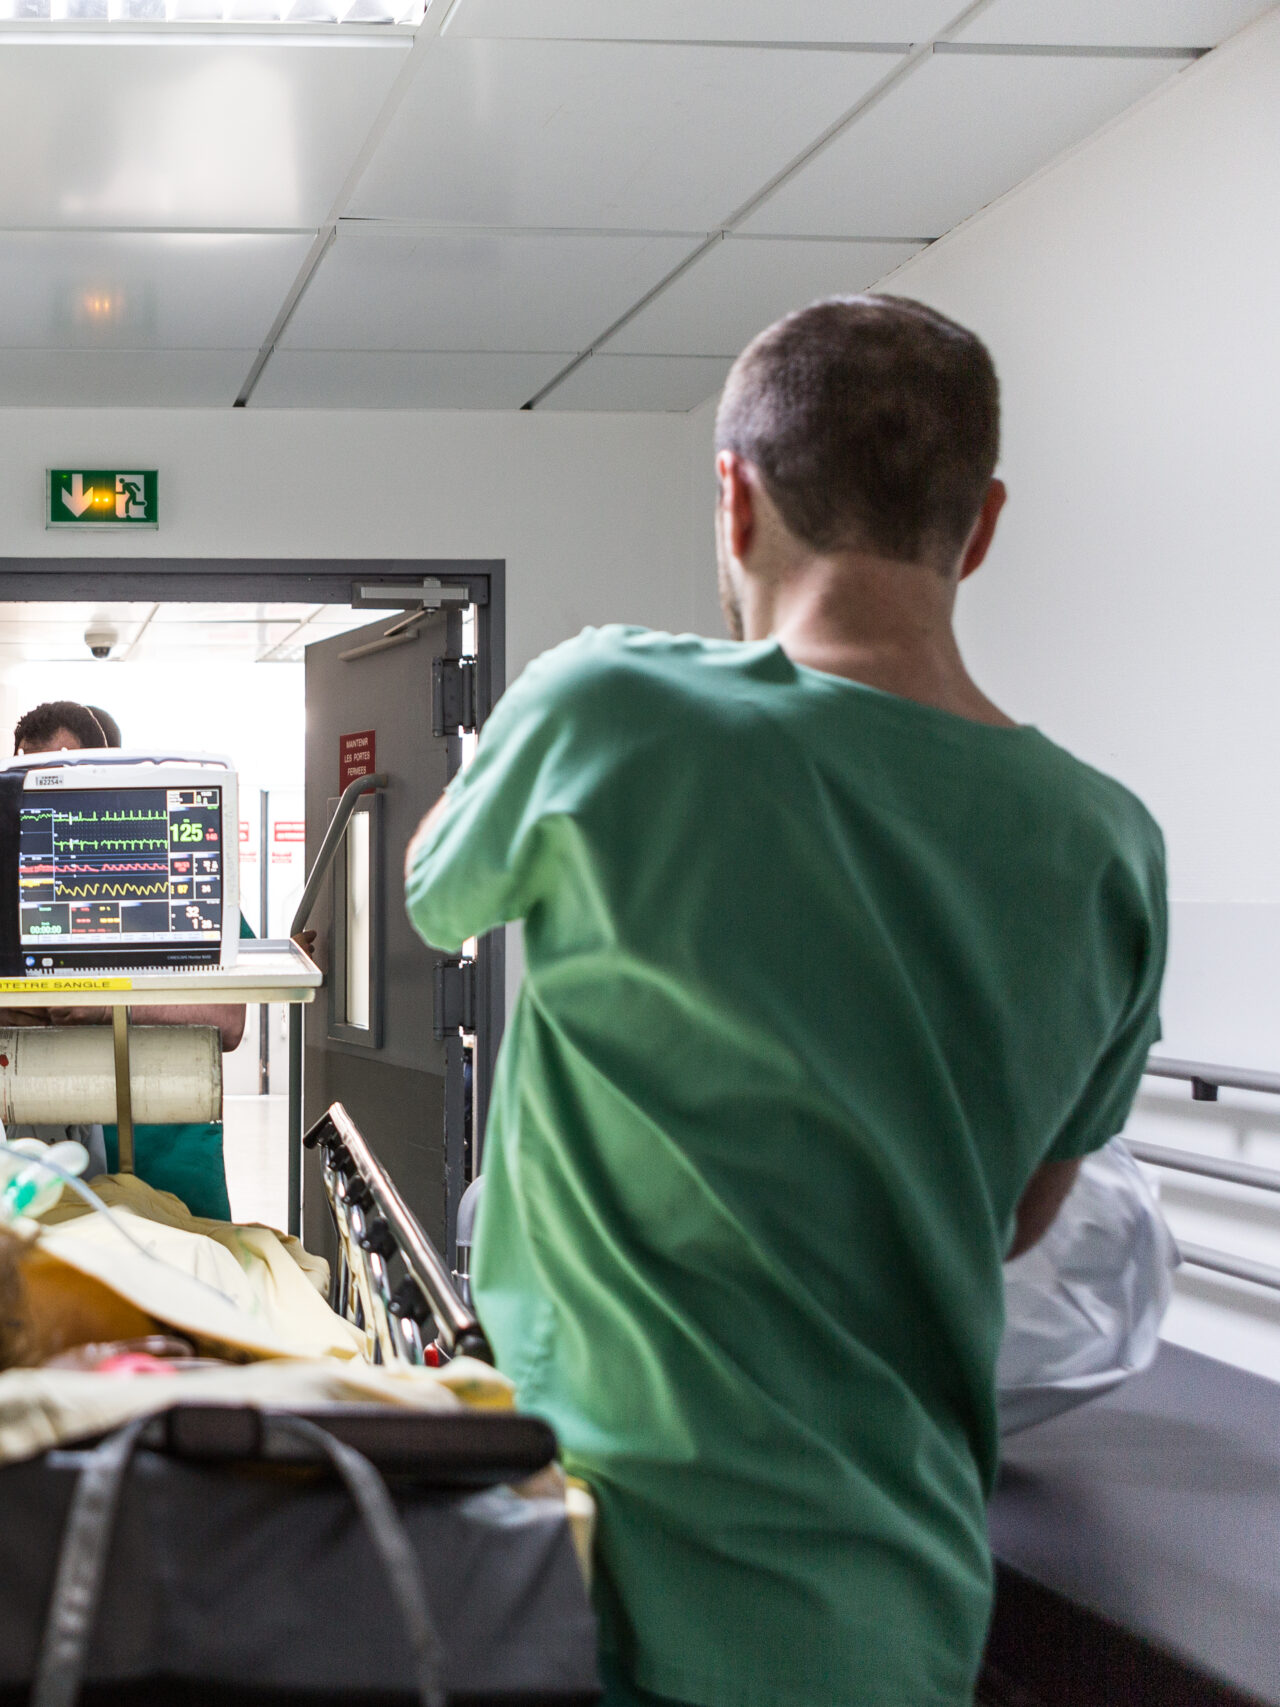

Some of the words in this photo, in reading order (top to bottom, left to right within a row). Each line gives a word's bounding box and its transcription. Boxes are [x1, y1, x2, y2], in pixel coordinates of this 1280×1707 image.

[346, 737, 368, 748] MAINTENIR
[344, 754, 353, 763] LES
[353, 751, 370, 761] PORTES
[348, 766, 366, 775] FERMEES
[170, 823, 203, 842] 125
[53, 981, 111, 989] SANGLE
